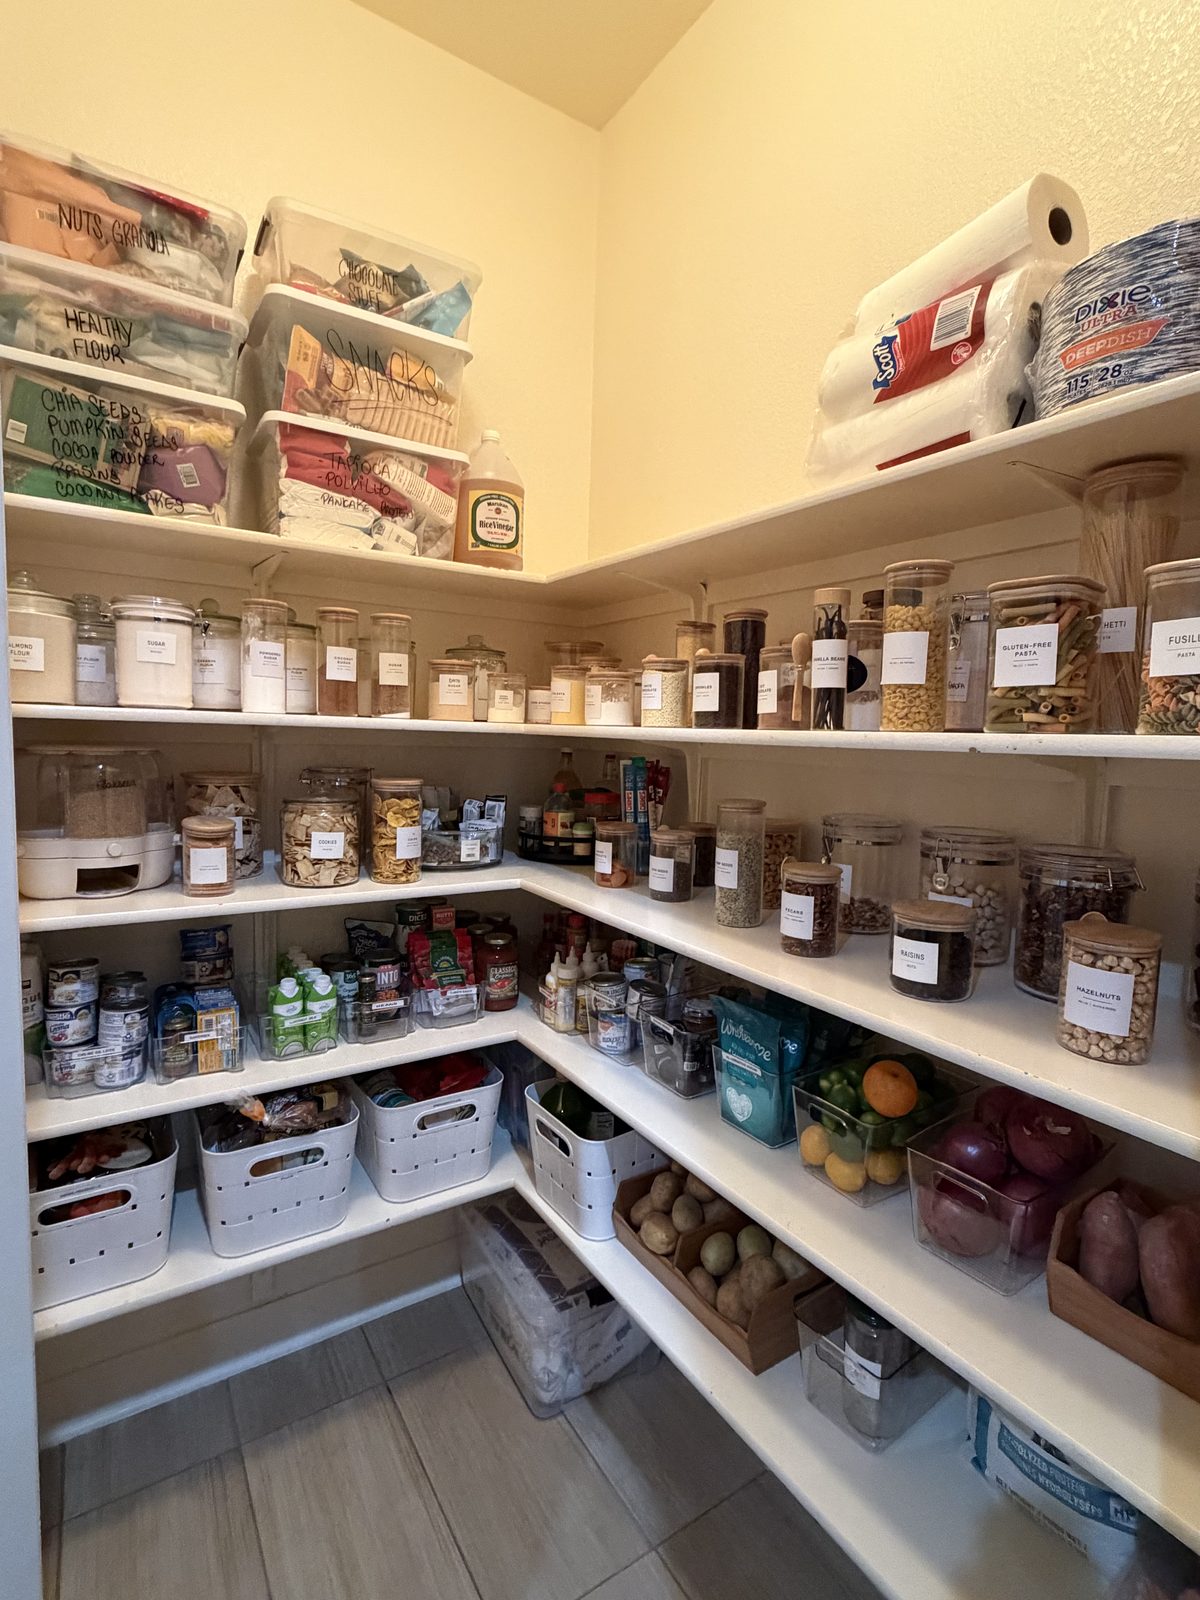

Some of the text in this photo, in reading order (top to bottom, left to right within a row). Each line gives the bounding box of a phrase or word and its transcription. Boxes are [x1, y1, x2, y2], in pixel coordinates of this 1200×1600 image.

[112, 219, 170, 256] GRANOLA
[338, 258, 399, 295] CHOCOLATE
[348, 282, 382, 312] STUFF
[64, 308, 133, 347] HEALTHY
[1081, 304, 1138, 333] ULTRA
[73, 338, 125, 364] FLOUR
[873, 343, 895, 382] Scott
[324, 328, 439, 407] SNACKS
[1066, 374, 1090, 394] 115
[1098, 363, 1123, 382] 28
[88, 394, 142, 424] SEEDS
[52, 438, 165, 467] COCOA POWDER
[130, 426, 180, 450] SEEDS
[319, 492, 371, 514] PANCAKE
[1002, 641, 1052, 652] GLUTEN-FREE
[900, 949, 925, 961] RAISINS
[1076, 985, 1122, 1001] HAZELNUTS
